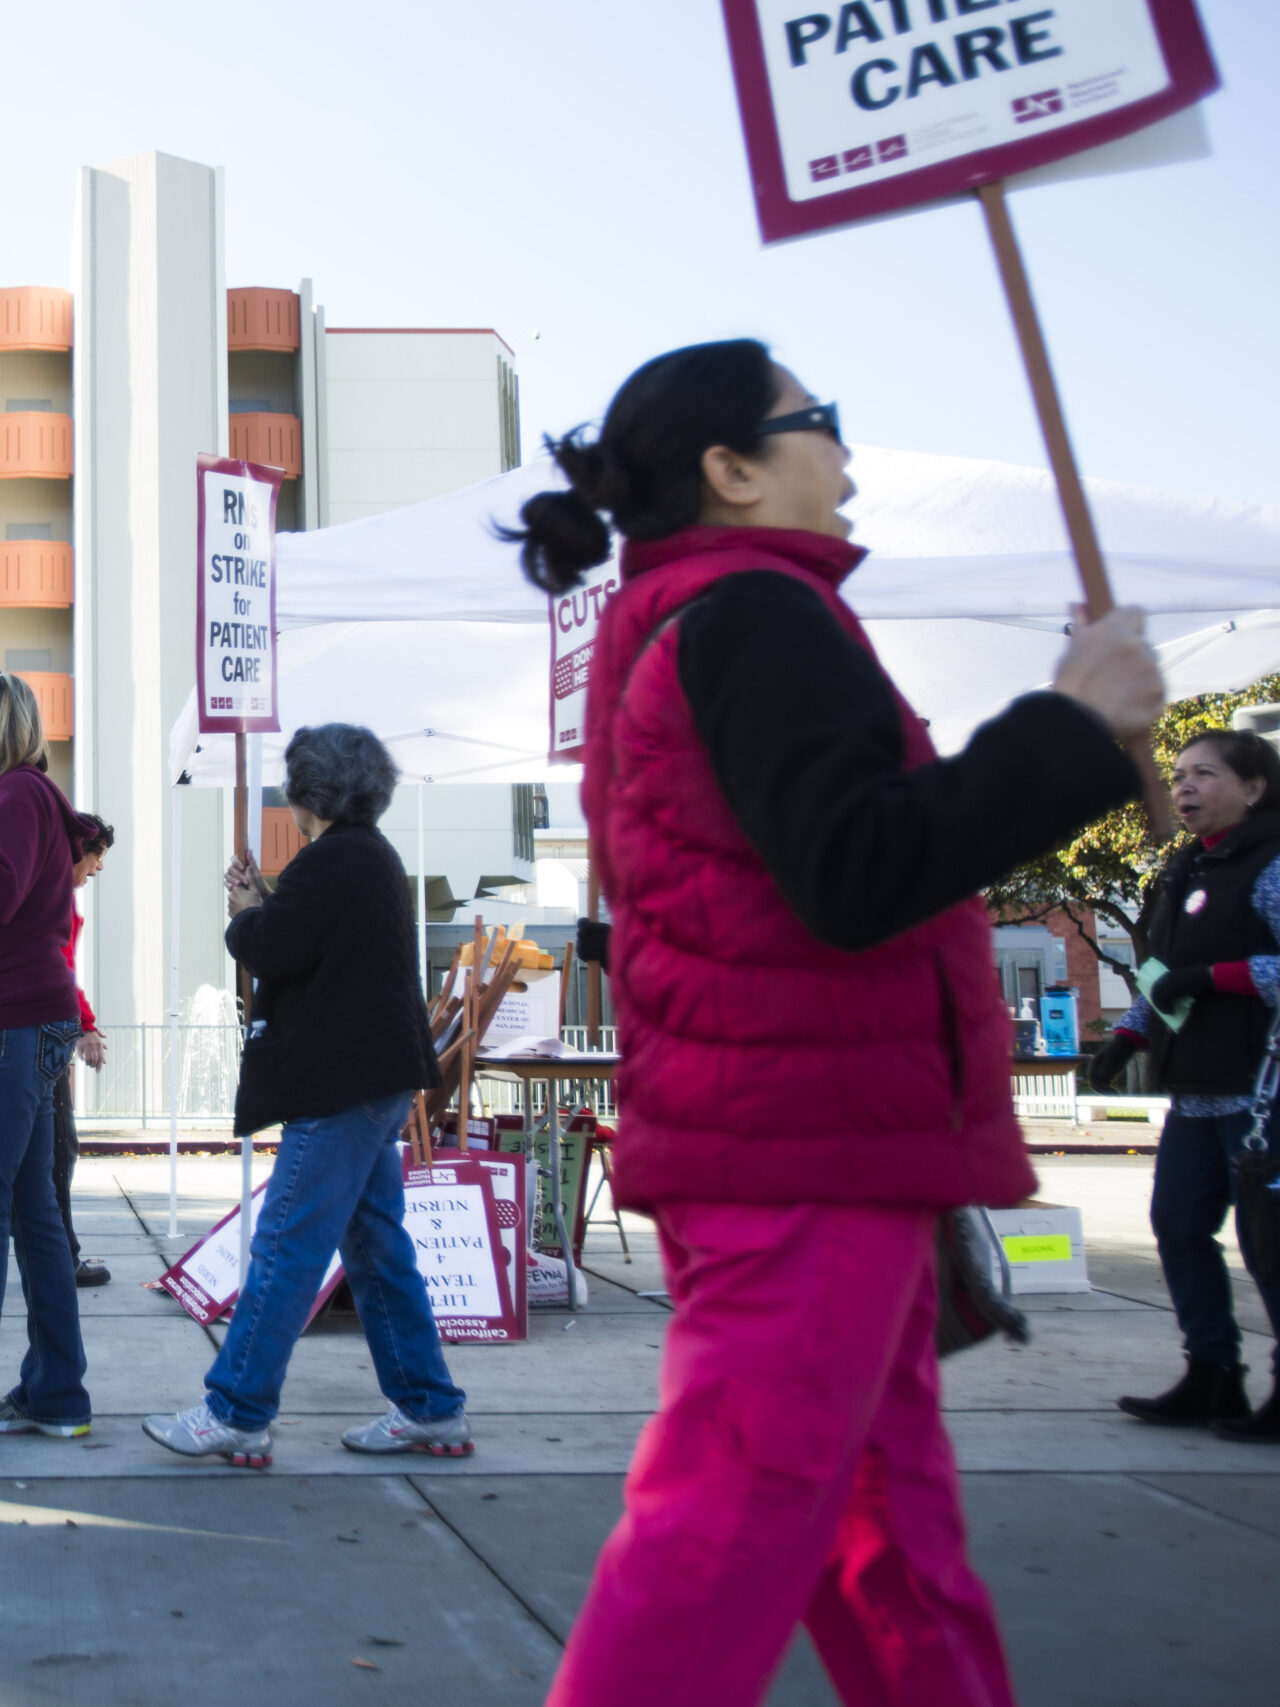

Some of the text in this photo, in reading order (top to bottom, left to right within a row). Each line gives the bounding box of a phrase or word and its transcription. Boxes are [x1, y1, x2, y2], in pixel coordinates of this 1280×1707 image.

[850, 9, 1064, 111] CARE
[234, 532, 250, 551] on
[211, 553, 267, 589] STRIKE
[233, 591, 251, 617] for
[209, 621, 268, 650] PATIENT
[221, 655, 260, 683] CARE
[430, 1218, 442, 1230] &
[417, 1237, 484, 1249] PATIEN
[437, 1253, 446, 1264] 4
[424, 1274, 478, 1287] TEAM
[430, 1294, 468, 1307] LIFT
[446, 1328, 508, 1339] California
